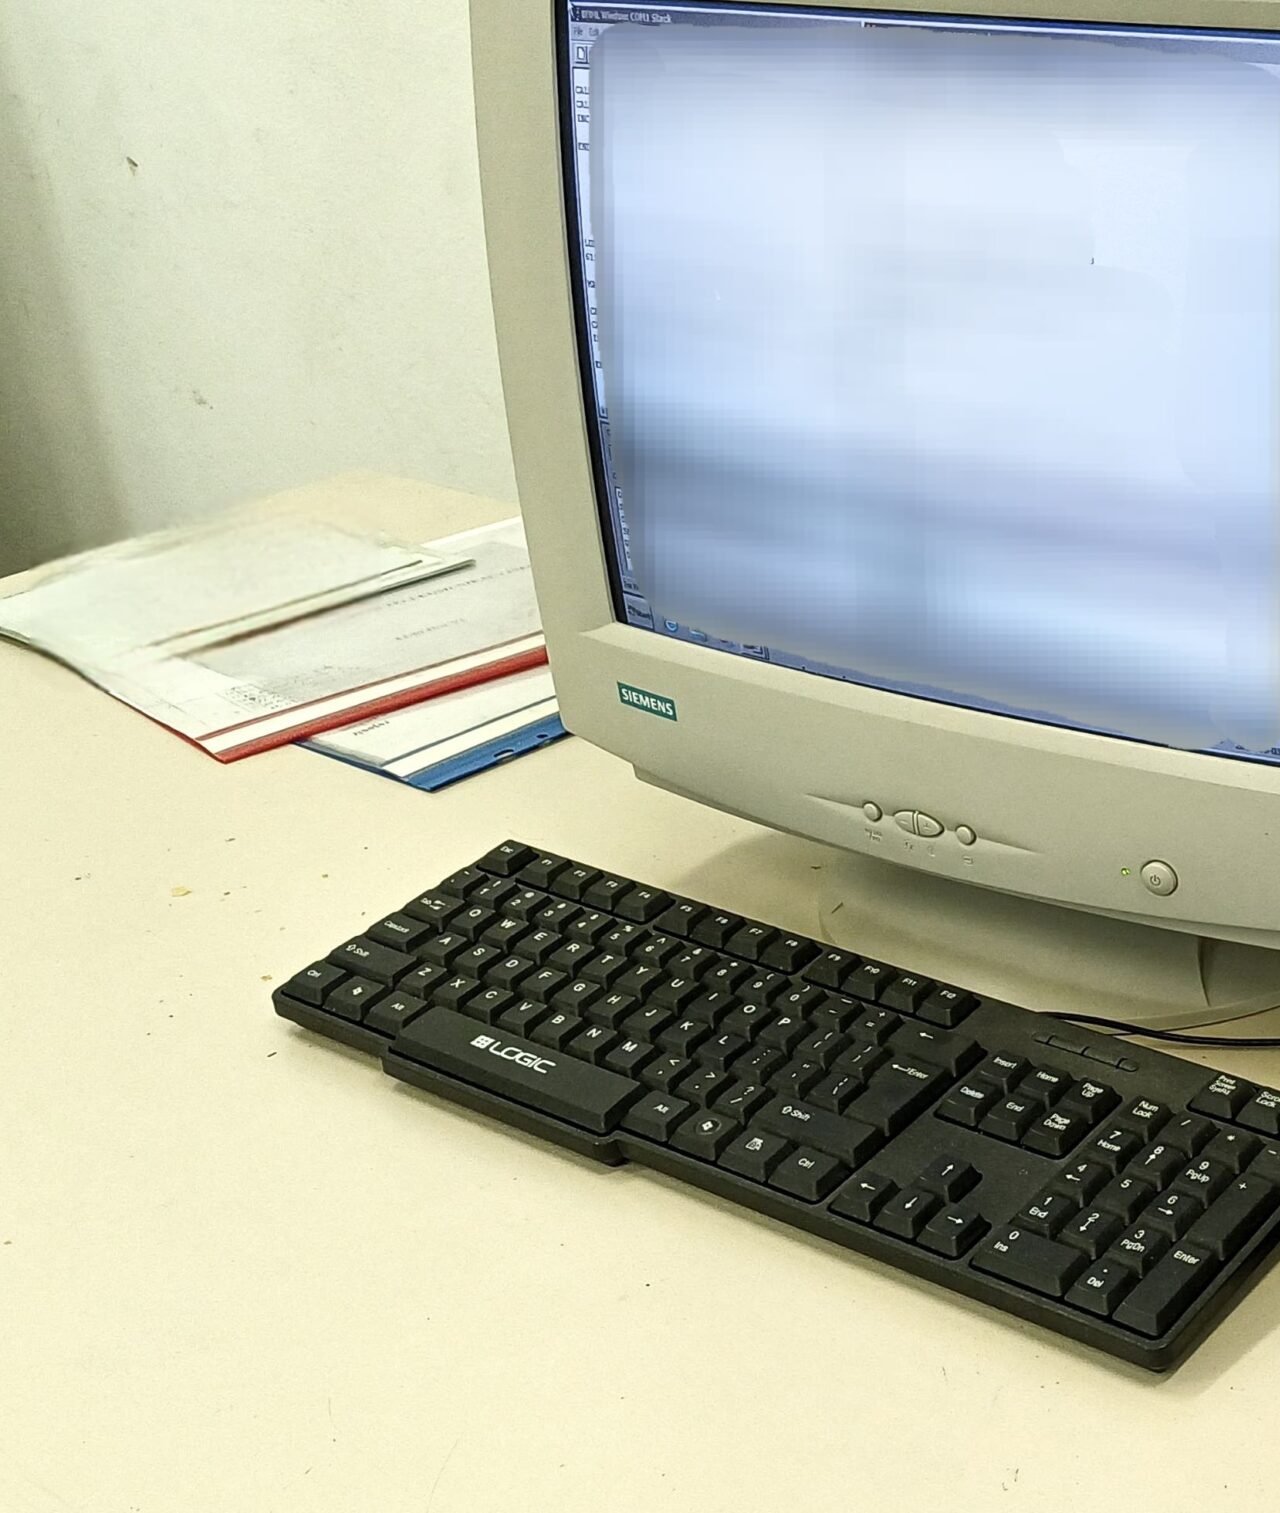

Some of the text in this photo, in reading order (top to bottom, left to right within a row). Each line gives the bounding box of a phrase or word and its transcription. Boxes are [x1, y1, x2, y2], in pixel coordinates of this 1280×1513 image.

[621, 688, 673, 715] SIEMENS
[501, 919, 516, 928] W
[534, 932, 547, 940] E
[567, 944, 579, 952] R
[602, 955, 613, 963] T
[418, 968, 431, 976] Z
[451, 979, 465, 987] X
[671, 979, 684, 987] U
[607, 996, 621, 1004] H
[744, 1005, 755, 1013] O
[552, 1015, 564, 1023] B
[680, 1022, 693, 1030] K
[587, 1028, 601, 1037] N
[719, 1036, 727, 1044] L
[622, 1042, 637, 1052] M
[489, 1042, 556, 1073] LOGIC
[994, 1057, 1017, 1068] Insert
[908, 1067, 928, 1079] Enter
[1037, 1072, 1058, 1082] Home
[960, 1087, 984, 1098] Delete
[1006, 1102, 1024, 1111] End
[1139, 1101, 1159, 1112] Num
[1256, 1097, 1276, 1108] Lock
[654, 1105, 668, 1113] Alt
[1132, 1108, 1153, 1119] Lock
[791, 1110, 810, 1121] Shift
[1050, 1114, 1070, 1125] Page
[1098, 1140, 1120, 1151] Home
[1154, 1146, 1163, 1154] 8
[799, 1158, 814, 1168] Ctrl
[1199, 1162, 1209, 1170] 9
[1186, 1169, 1209, 1182] PgUp
[1121, 1180, 1132, 1188] 5
[1045, 1197, 1052, 1205] 1
[1168, 1196, 1178, 1204] 6
[1029, 1207, 1048, 1218] End
[1089, 1213, 1099, 1222] 2
[1009, 1231, 1019, 1239] 0
[1135, 1230, 1144, 1238] 3
[994, 1242, 1008, 1251] Ins
[1121, 1239, 1144, 1252] PgDn
[1174, 1251, 1199, 1264] Enter
[1087, 1277, 1104, 1287] Del
